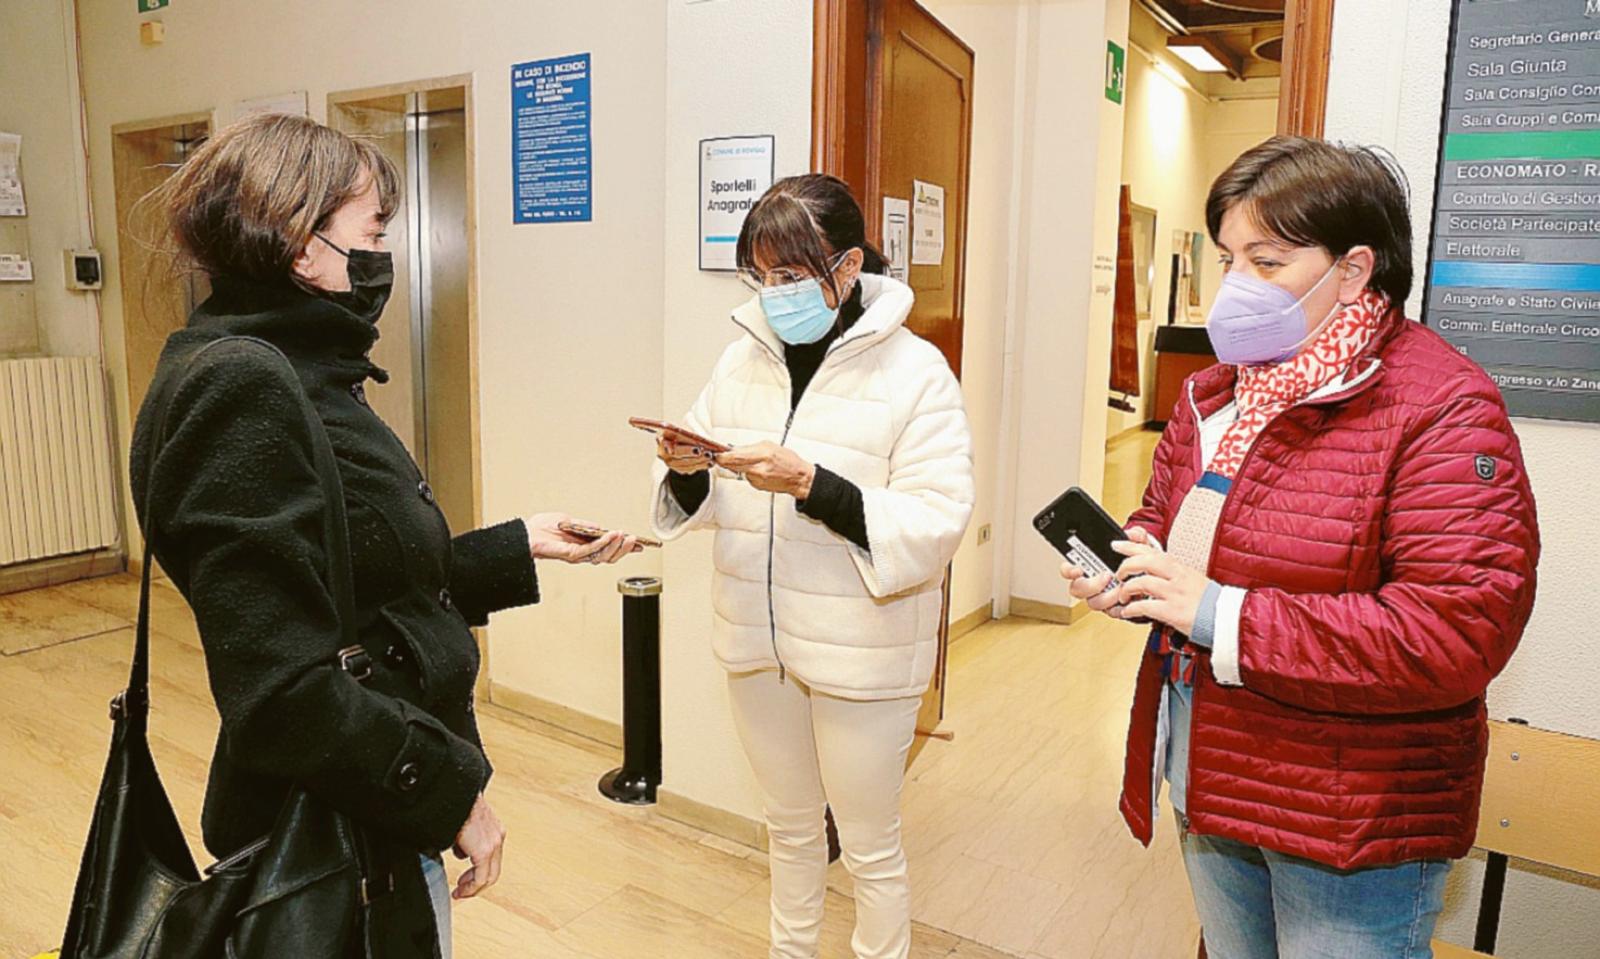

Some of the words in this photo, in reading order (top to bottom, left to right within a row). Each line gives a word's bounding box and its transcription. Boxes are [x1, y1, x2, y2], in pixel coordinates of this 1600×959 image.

[1469, 34, 1543, 49] Segretario
[524, 66, 543, 77] CASO
[1467, 63, 1504, 77] Sala
[1510, 59, 1567, 74] Giunta
[1464, 88, 1494, 101] Sala
[1499, 86, 1567, 101] Consiglio
[1461, 115, 1491, 127] Sala
[1496, 113, 1544, 128] Gruppi
[1548, 114, 1558, 124] e
[1562, 112, 1600, 124] Com
[1457, 164, 1566, 178] ECONOMATO
[1584, 163, 1600, 176] R
[711, 179, 756, 194] Sportelli
[1453, 191, 1519, 205] Controllo
[1522, 191, 1537, 204] di
[1449, 214, 1506, 230] Società
[1511, 217, 1600, 233] Partecipate
[1446, 243, 1520, 256] Elettorale
[1443, 293, 1504, 307] Anagrafe
[1508, 296, 1516, 306] e
[1520, 295, 1556, 309] Stato
[1438, 318, 1487, 332] Comm.
[1491, 320, 1557, 335] Elettorale
[1561, 323, 1600, 337] Circo
